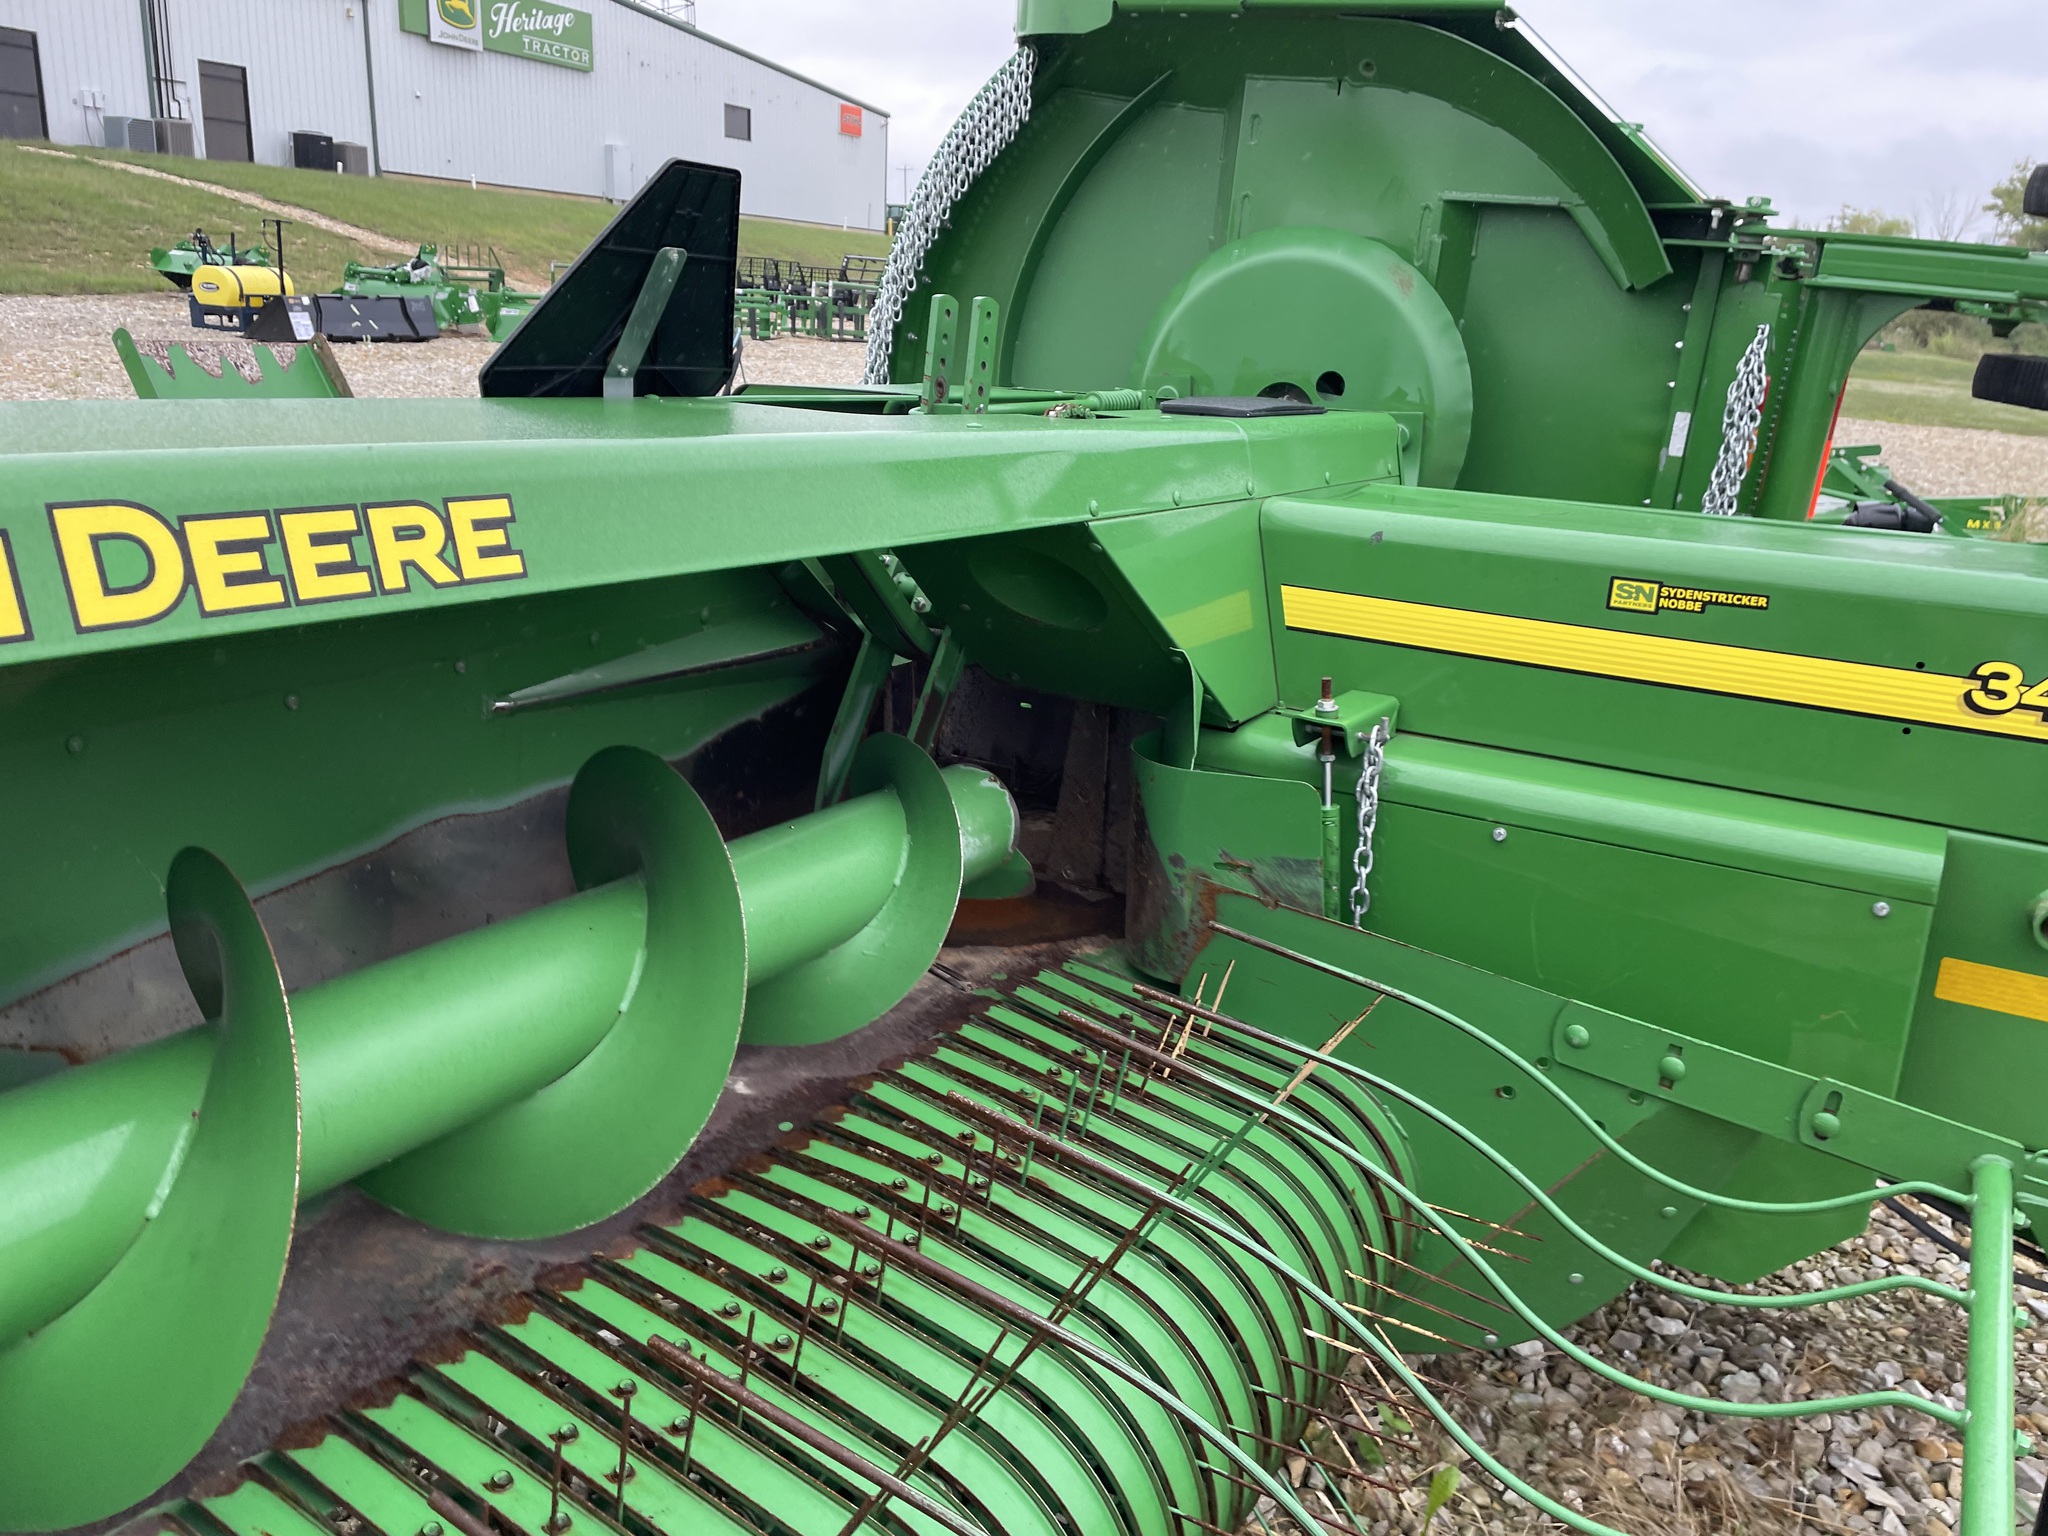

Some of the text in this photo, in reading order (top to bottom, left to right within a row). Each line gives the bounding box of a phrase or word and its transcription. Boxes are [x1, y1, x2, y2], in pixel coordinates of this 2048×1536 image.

[488, 1, 575, 38] Heritage
[438, 30, 479, 46] JOHN DEERE
[522, 37, 589, 64] TRACTOR
[45, 493, 528, 634] DEERE
[1613, 599, 1653, 609] PARTNERS
[1658, 598, 1703, 612] NOBBE
[1660, 586, 1768, 608] SYDENSTRICKER
